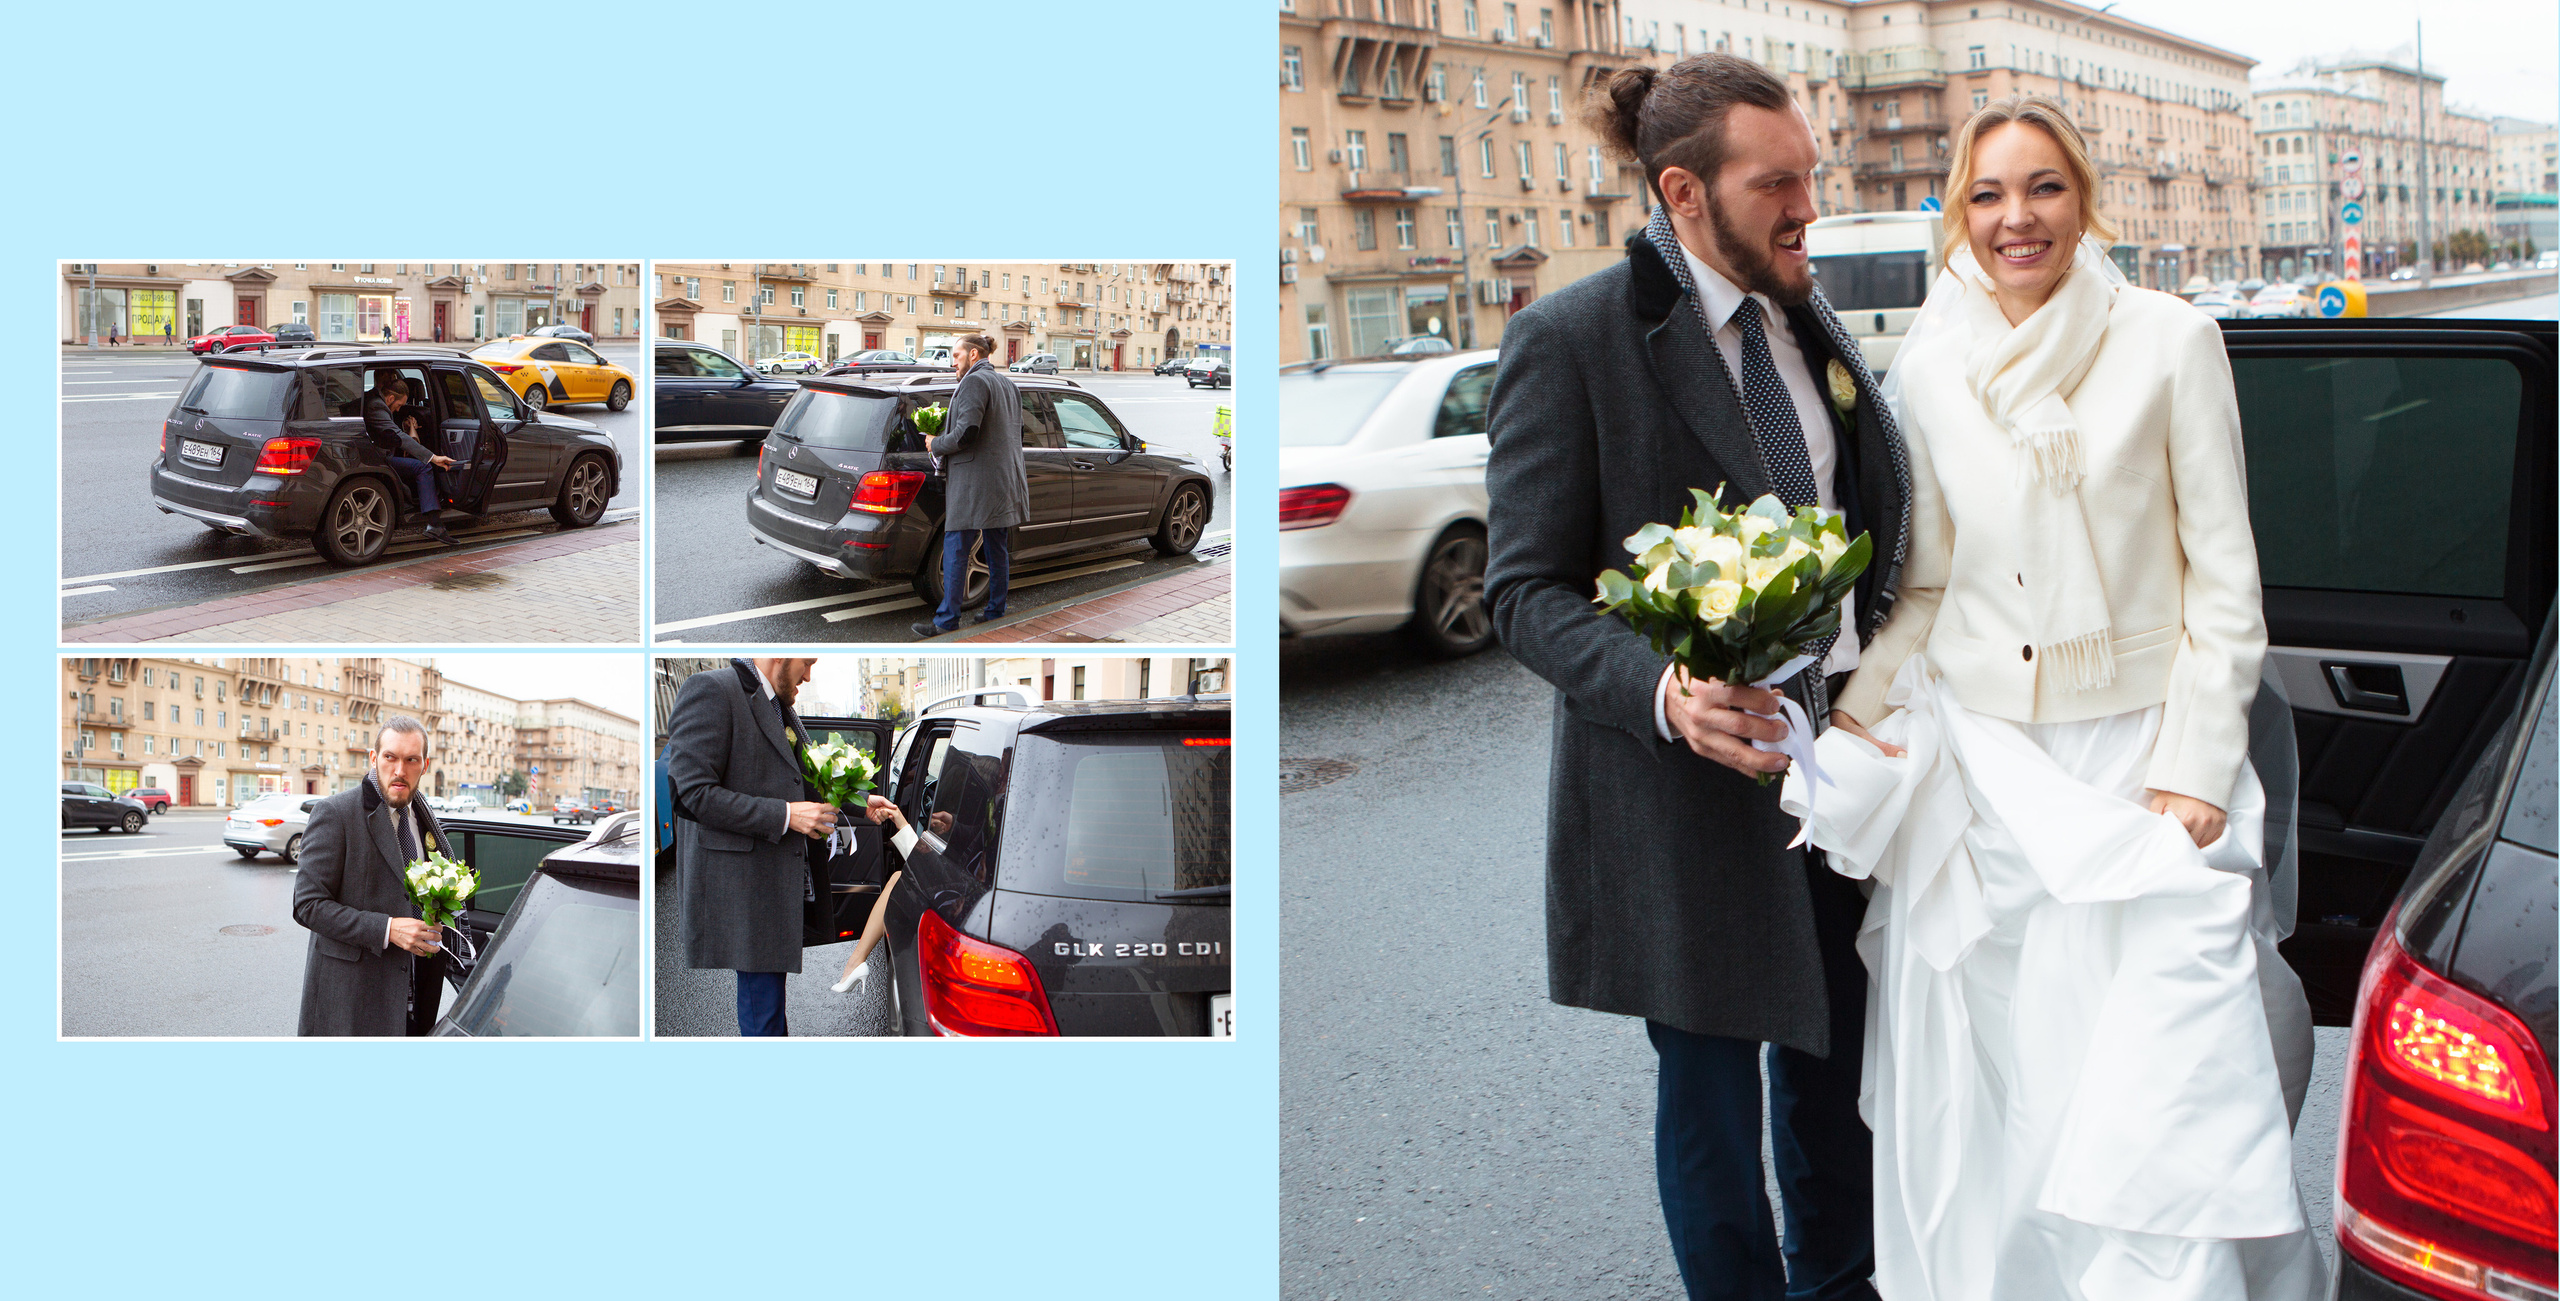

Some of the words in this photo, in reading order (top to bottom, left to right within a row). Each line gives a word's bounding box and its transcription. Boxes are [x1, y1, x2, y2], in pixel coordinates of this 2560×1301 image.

[132, 314, 172, 325] ПРОДАЖА
[787, 344, 816, 352] ПРОДАЖА
[1053, 941, 1105, 957] GLK
[1115, 942, 1168, 957] 220
[1178, 941, 1222, 956] CDI
